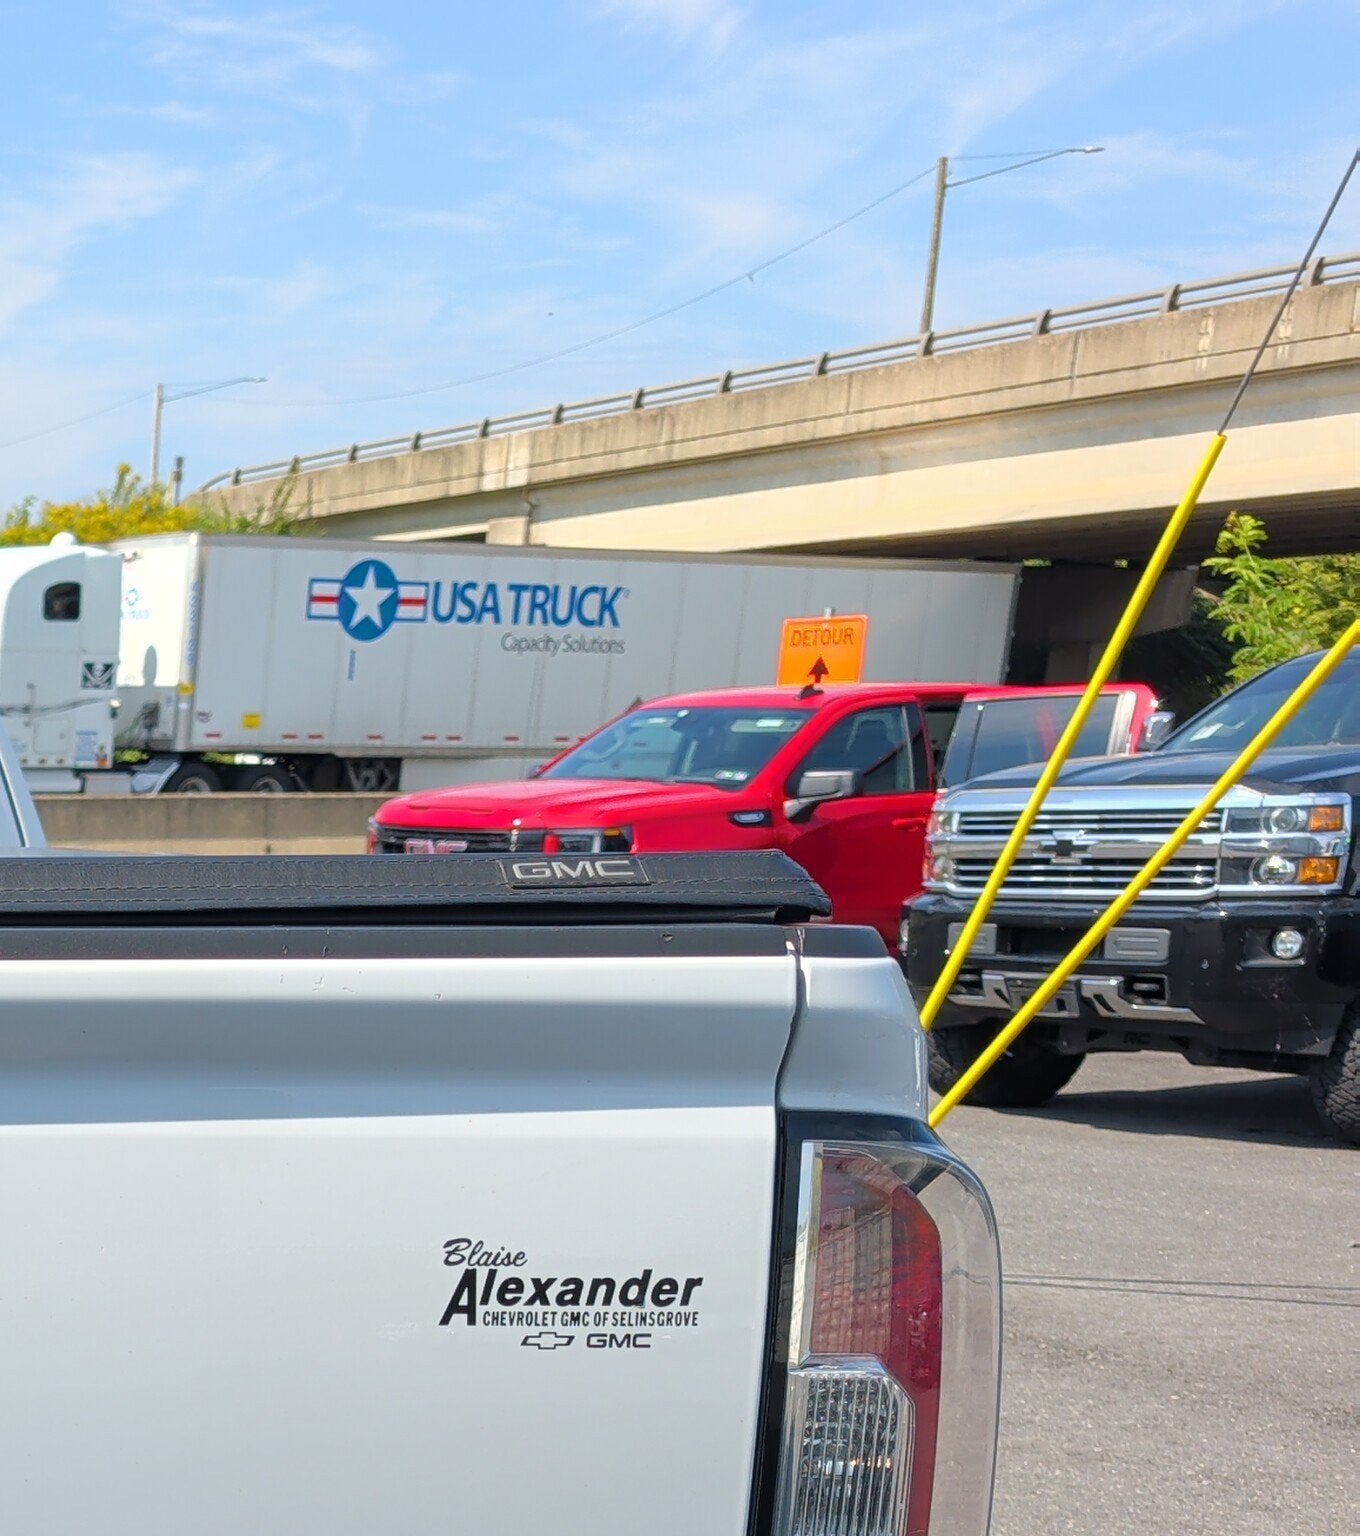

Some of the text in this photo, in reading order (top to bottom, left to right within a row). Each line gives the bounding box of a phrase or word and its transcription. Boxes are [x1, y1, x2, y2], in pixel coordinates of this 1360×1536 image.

[432, 581, 623, 629] USA TRUCK
[500, 632, 627, 657] Capacity Solutions
[790, 627, 855, 647] DETOUR
[511, 860, 635, 879] GMC
[442, 1237, 528, 1267] Blaise
[438, 1268, 704, 1327] Alexander
[482, 1310, 699, 1328] CHEVROLET GMC OF SELINSGROVE
[586, 1333, 652, 1349] GMC
